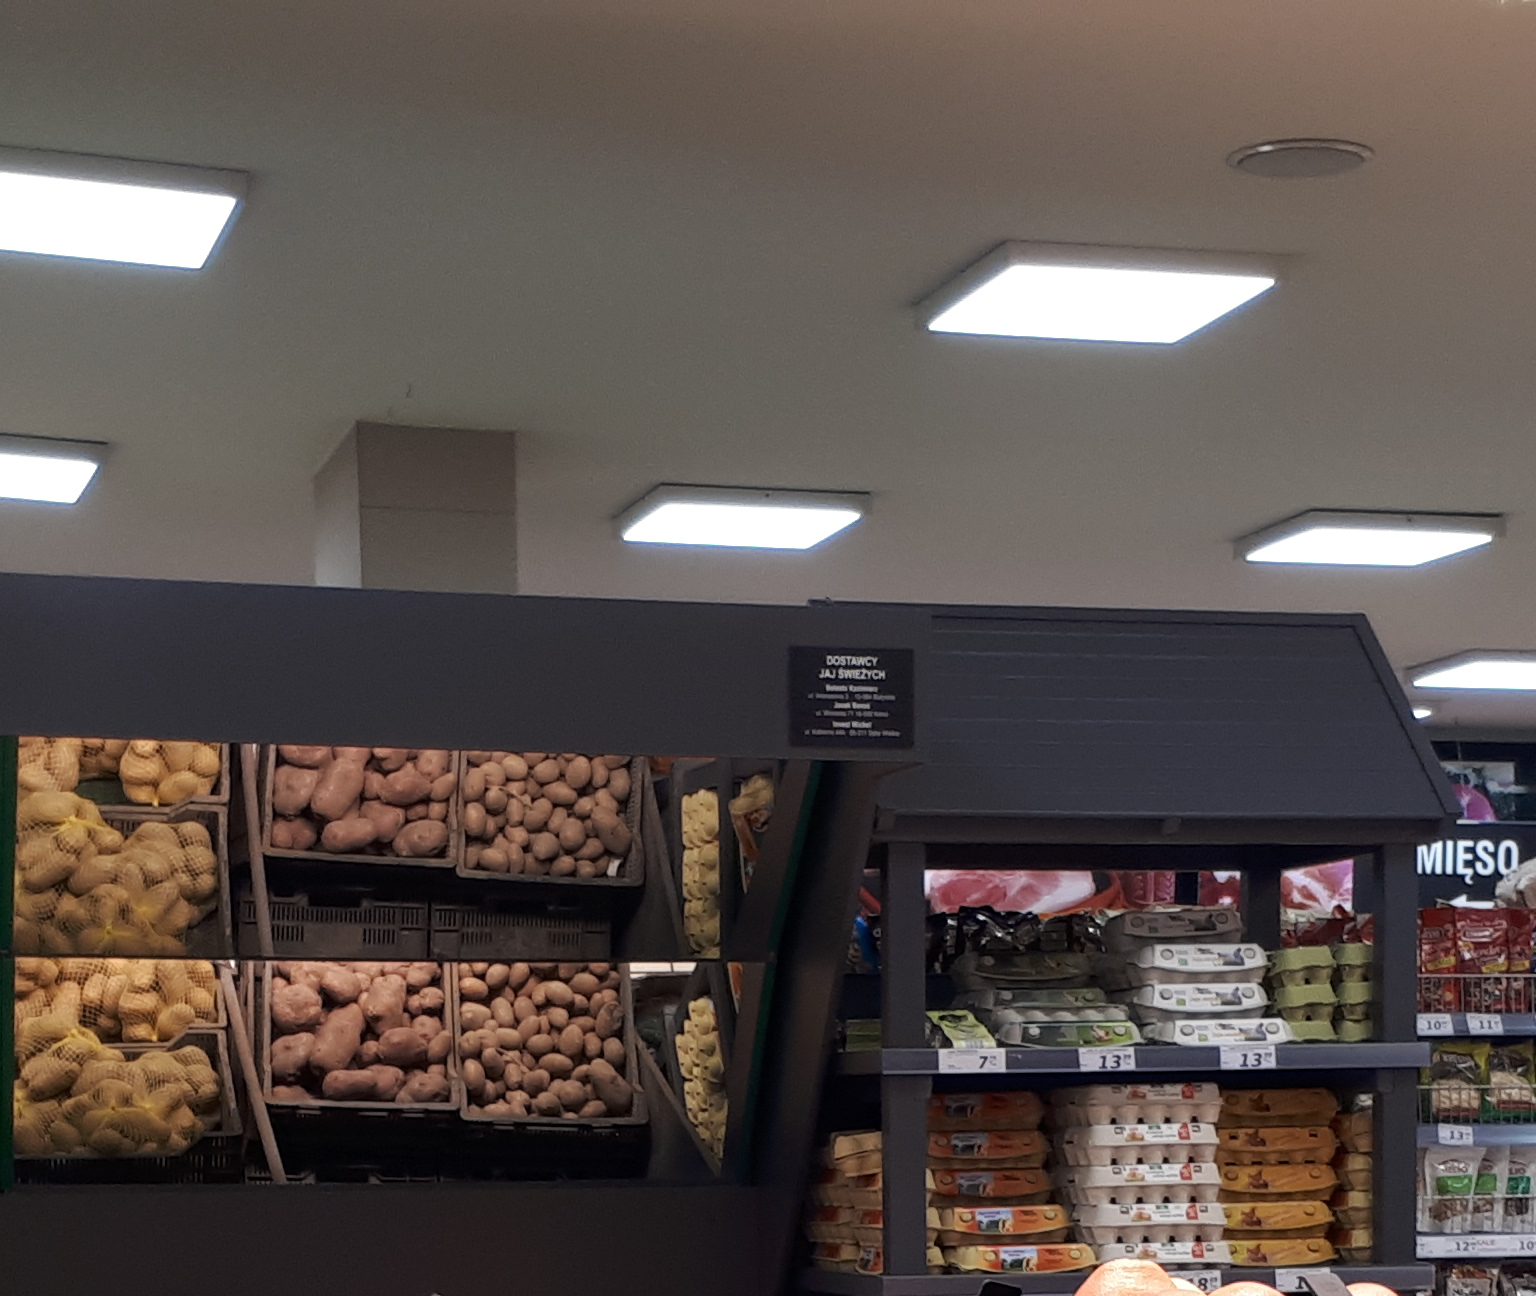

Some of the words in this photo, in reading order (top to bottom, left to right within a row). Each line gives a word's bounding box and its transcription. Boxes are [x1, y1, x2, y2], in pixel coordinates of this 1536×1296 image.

[826, 655, 878, 667] DOSTAWCY
[819, 668, 836, 679] JAJ
[838, 667, 886, 680] ŚWIEŻYCH
[1417, 839, 1519, 885] MIĘSO
[978, 1055, 989, 1069] 7
[1098, 1054, 1121, 1069] 13
[1239, 1053, 1262, 1068] 13
